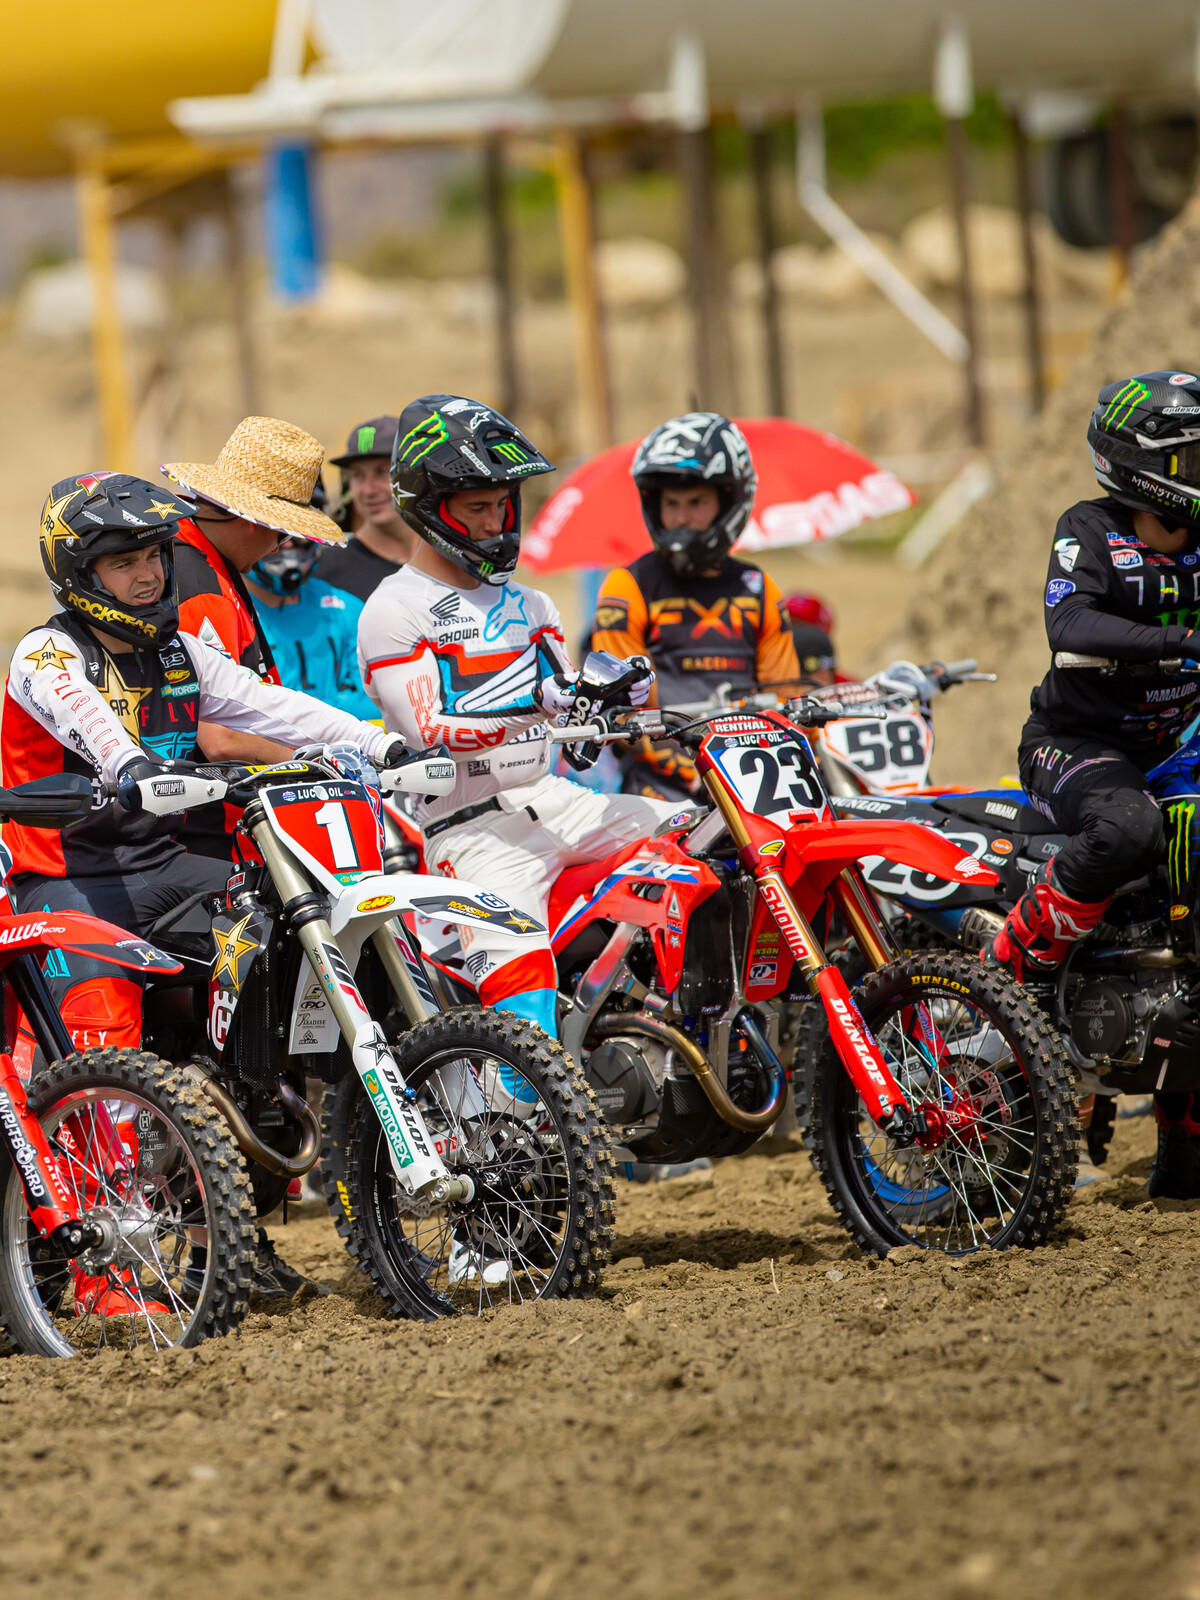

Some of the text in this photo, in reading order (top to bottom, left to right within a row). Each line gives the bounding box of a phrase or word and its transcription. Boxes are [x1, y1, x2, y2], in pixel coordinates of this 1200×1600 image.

[1131, 475, 1187, 507] MONSTER
[1115, 553, 1138, 565] 100%
[68, 591, 157, 639] ROCKSTAR
[433, 615, 477, 627] HONDA
[439, 627, 479, 647] SHOWA
[140, 701, 196, 727] FLY
[715, 720, 767, 732] RENTHAL
[768, 732, 782, 741] OIL
[846, 720, 925, 772] 58
[506, 757, 536, 768] DUNLOP
[328, 786, 344, 797] OIL
[739, 746, 823, 816] 23
[984, 801, 1018, 820] YAMAHA
[314, 801, 359, 869] 1
[612, 858, 700, 880] CRF
[359, 896, 395, 910] FMF
[760, 884, 811, 961] SHOWA
[911, 975, 971, 995] DUNLOP
[831, 997, 887, 1086] DUNLOP
[373, 1093, 412, 1166] MOTOREX
[43, 1156, 68, 1202] OAKLEY
